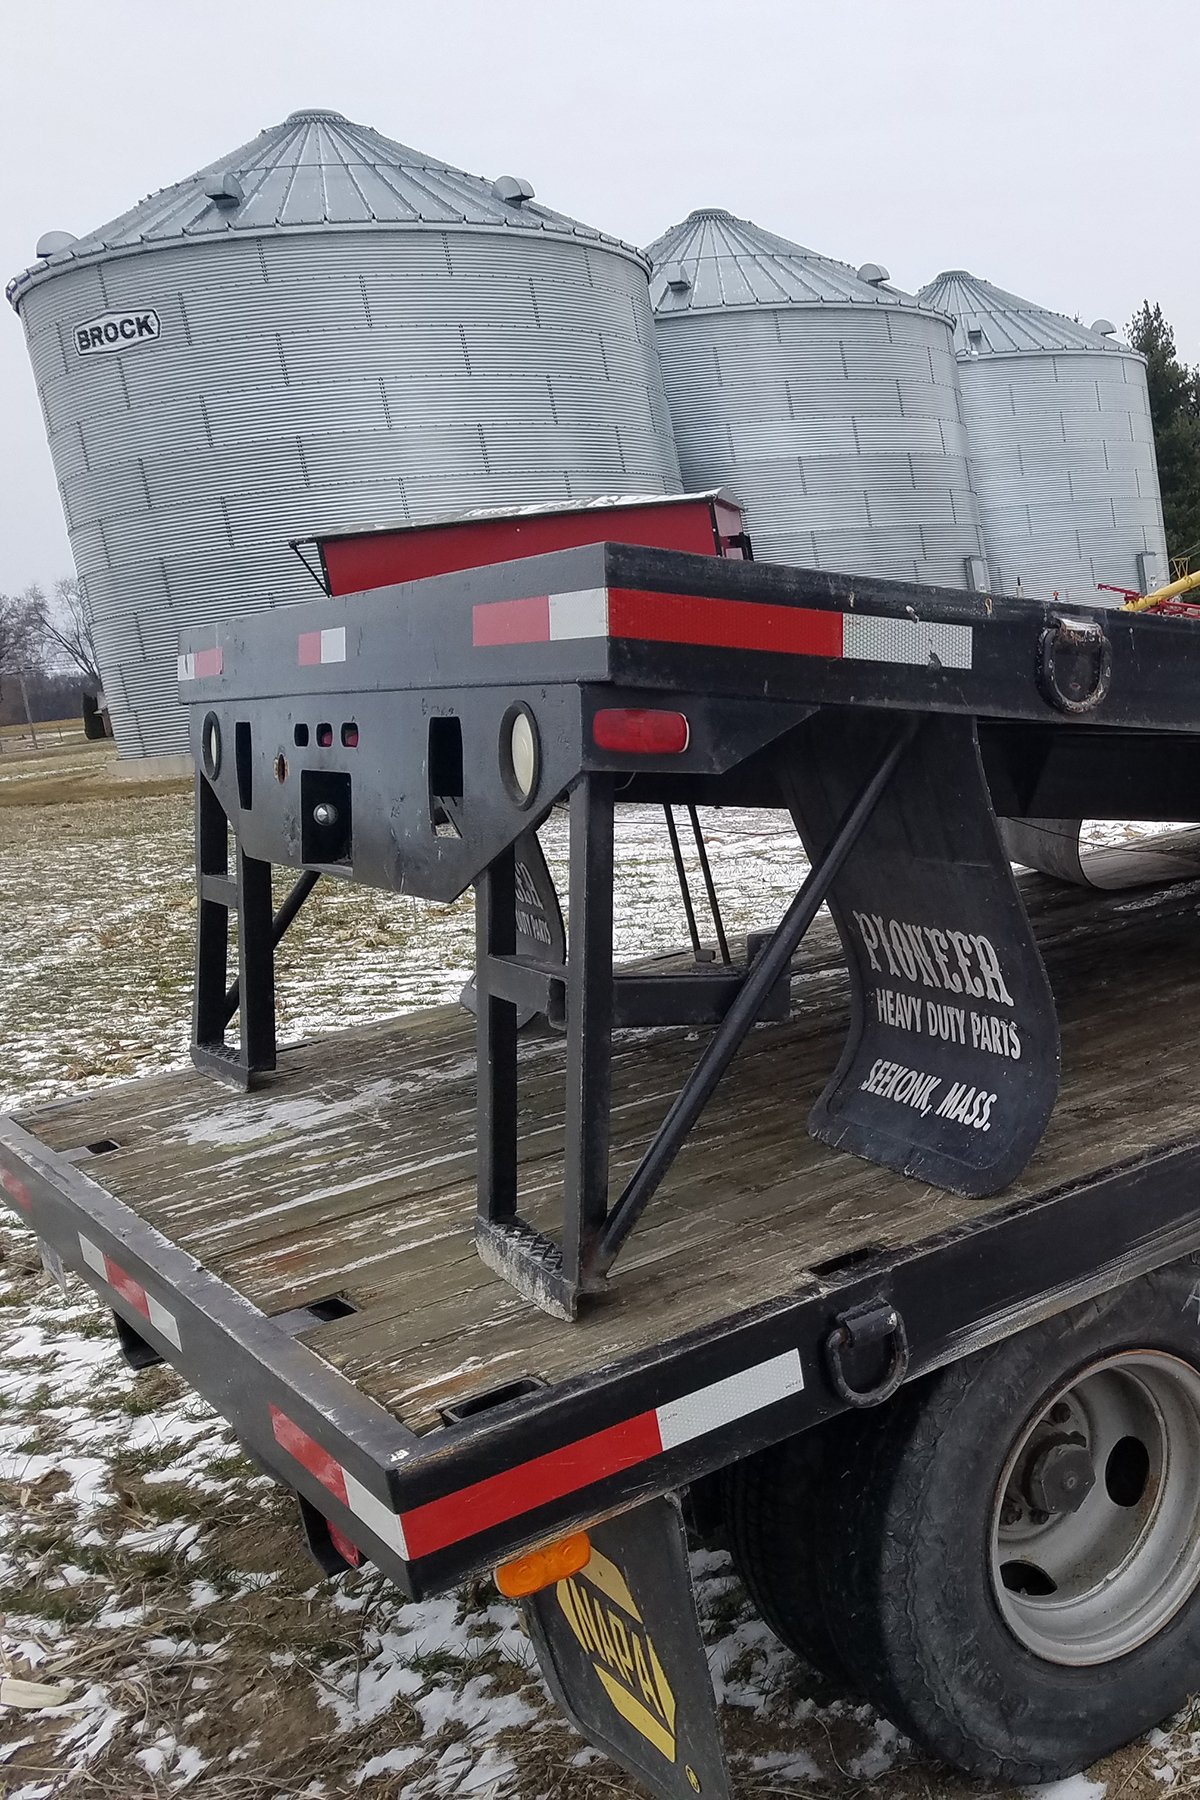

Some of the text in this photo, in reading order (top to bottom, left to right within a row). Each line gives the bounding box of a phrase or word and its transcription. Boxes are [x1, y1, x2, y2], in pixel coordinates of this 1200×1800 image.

[76, 314, 156, 351] BROCK
[852, 910, 1014, 1007] PIONEER
[876, 988, 1022, 1060] HEAVY DUTY PARTS
[860, 1058, 998, 1132] SEEKONK, MASS.
[567, 1576, 665, 1720] NAPA
